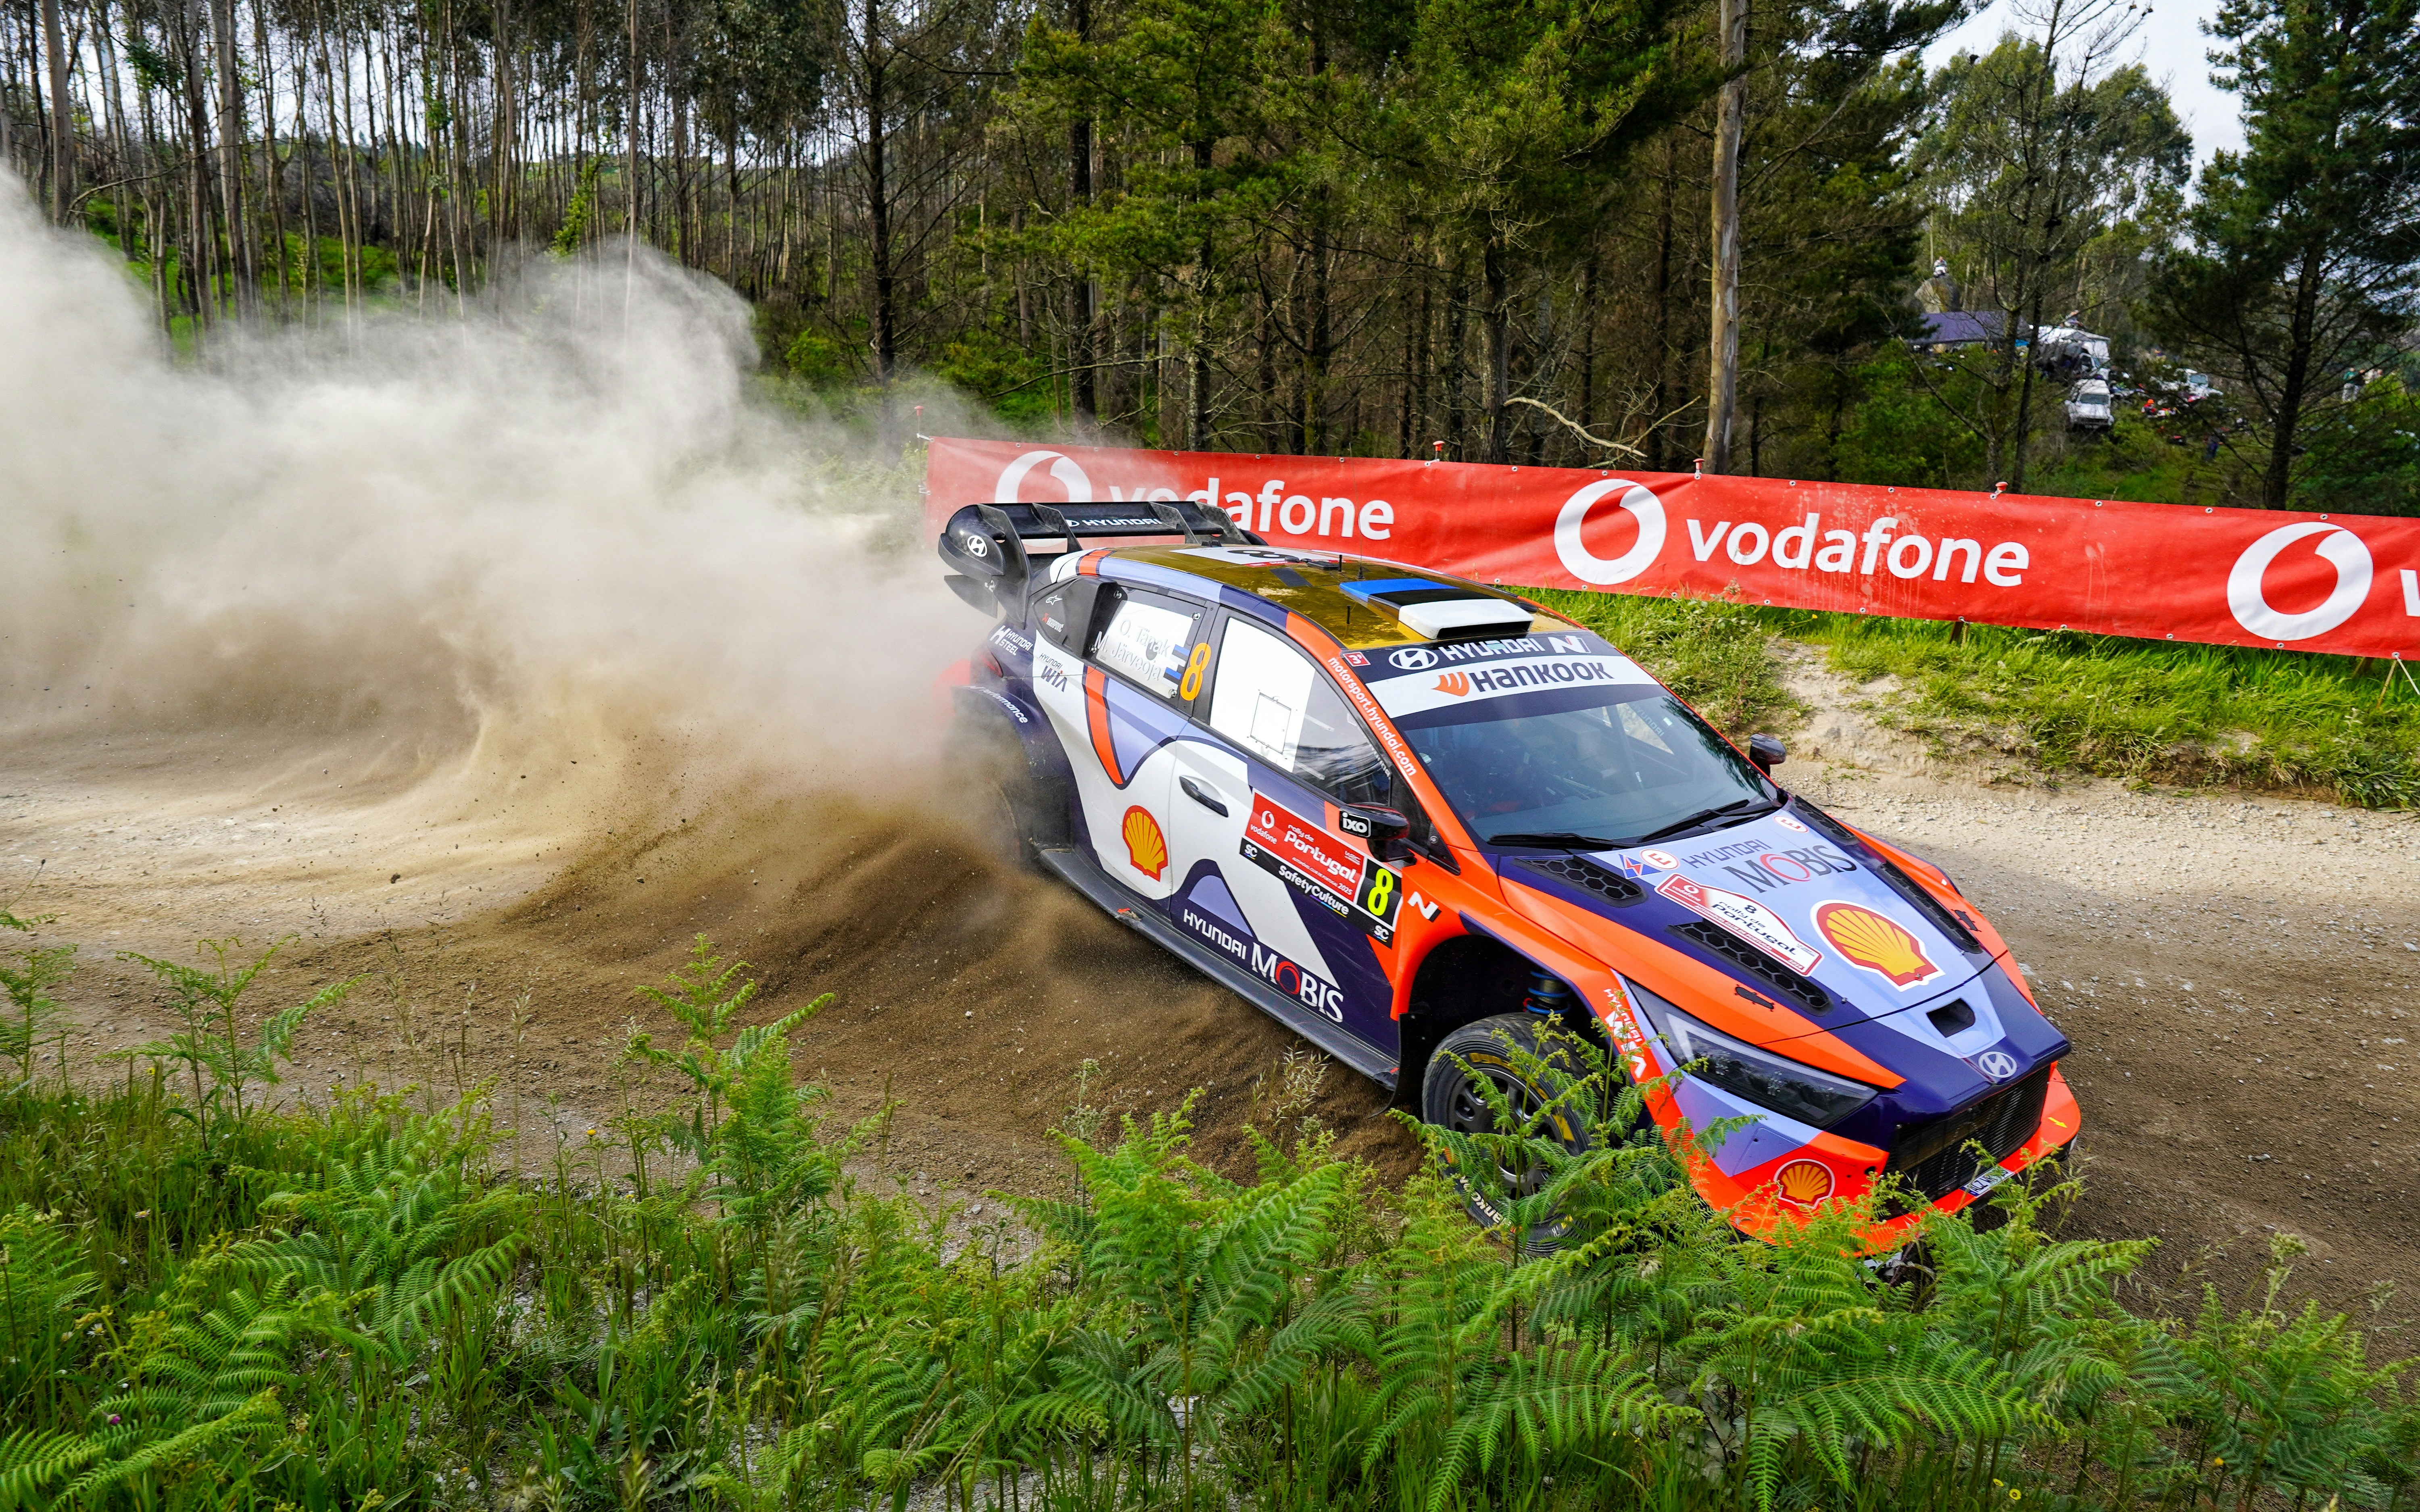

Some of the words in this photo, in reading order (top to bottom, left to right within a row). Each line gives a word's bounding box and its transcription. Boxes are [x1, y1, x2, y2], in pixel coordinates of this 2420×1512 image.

[1686, 512, 2030, 587] vodafone
[999, 639, 1019, 656] STEEL
[1006, 630, 1033, 651] HYUNDAI
[1120, 619, 1131, 637] O.
[1136, 625, 1170, 657] Tänak
[1438, 638, 1546, 660] HYUNDAI
[1039, 653, 1063, 670] HYUNDAI
[1094, 631, 1108, 653] M.
[1111, 641, 1161, 681] Järveoja
[1041, 665, 1068, 693] WIA
[1180, 642, 1212, 701] 8
[1327, 657, 1417, 777] motorsport.hyundai.com
[1250, 824, 1277, 844] vodafone
[1287, 824, 1305, 838] rally
[1304, 833, 1314, 842] de
[1342, 812, 1368, 833] ixo
[1244, 844, 1258, 858] SC
[1283, 830, 1356, 884] Portugal
[1648, 853, 1670, 866] E
[1681, 839, 1773, 869] HYUNDAI
[1721, 845, 1857, 893] MOBIS
[1279, 864, 1350, 916] SafetyCulture
[1337, 883, 1353, 895] 2025
[1367, 868, 1394, 916] 8
[1671, 885, 1702, 902] vodafone
[1407, 891, 1442, 922] N
[1719, 902, 1748, 918] rally
[1750, 918, 1767, 928] de
[1744, 905, 1757, 914] 8
[1183, 908, 1247, 960] HYUNDAI
[1374, 925, 1389, 940] SC
[1251, 941, 1344, 1023] MOBIS
